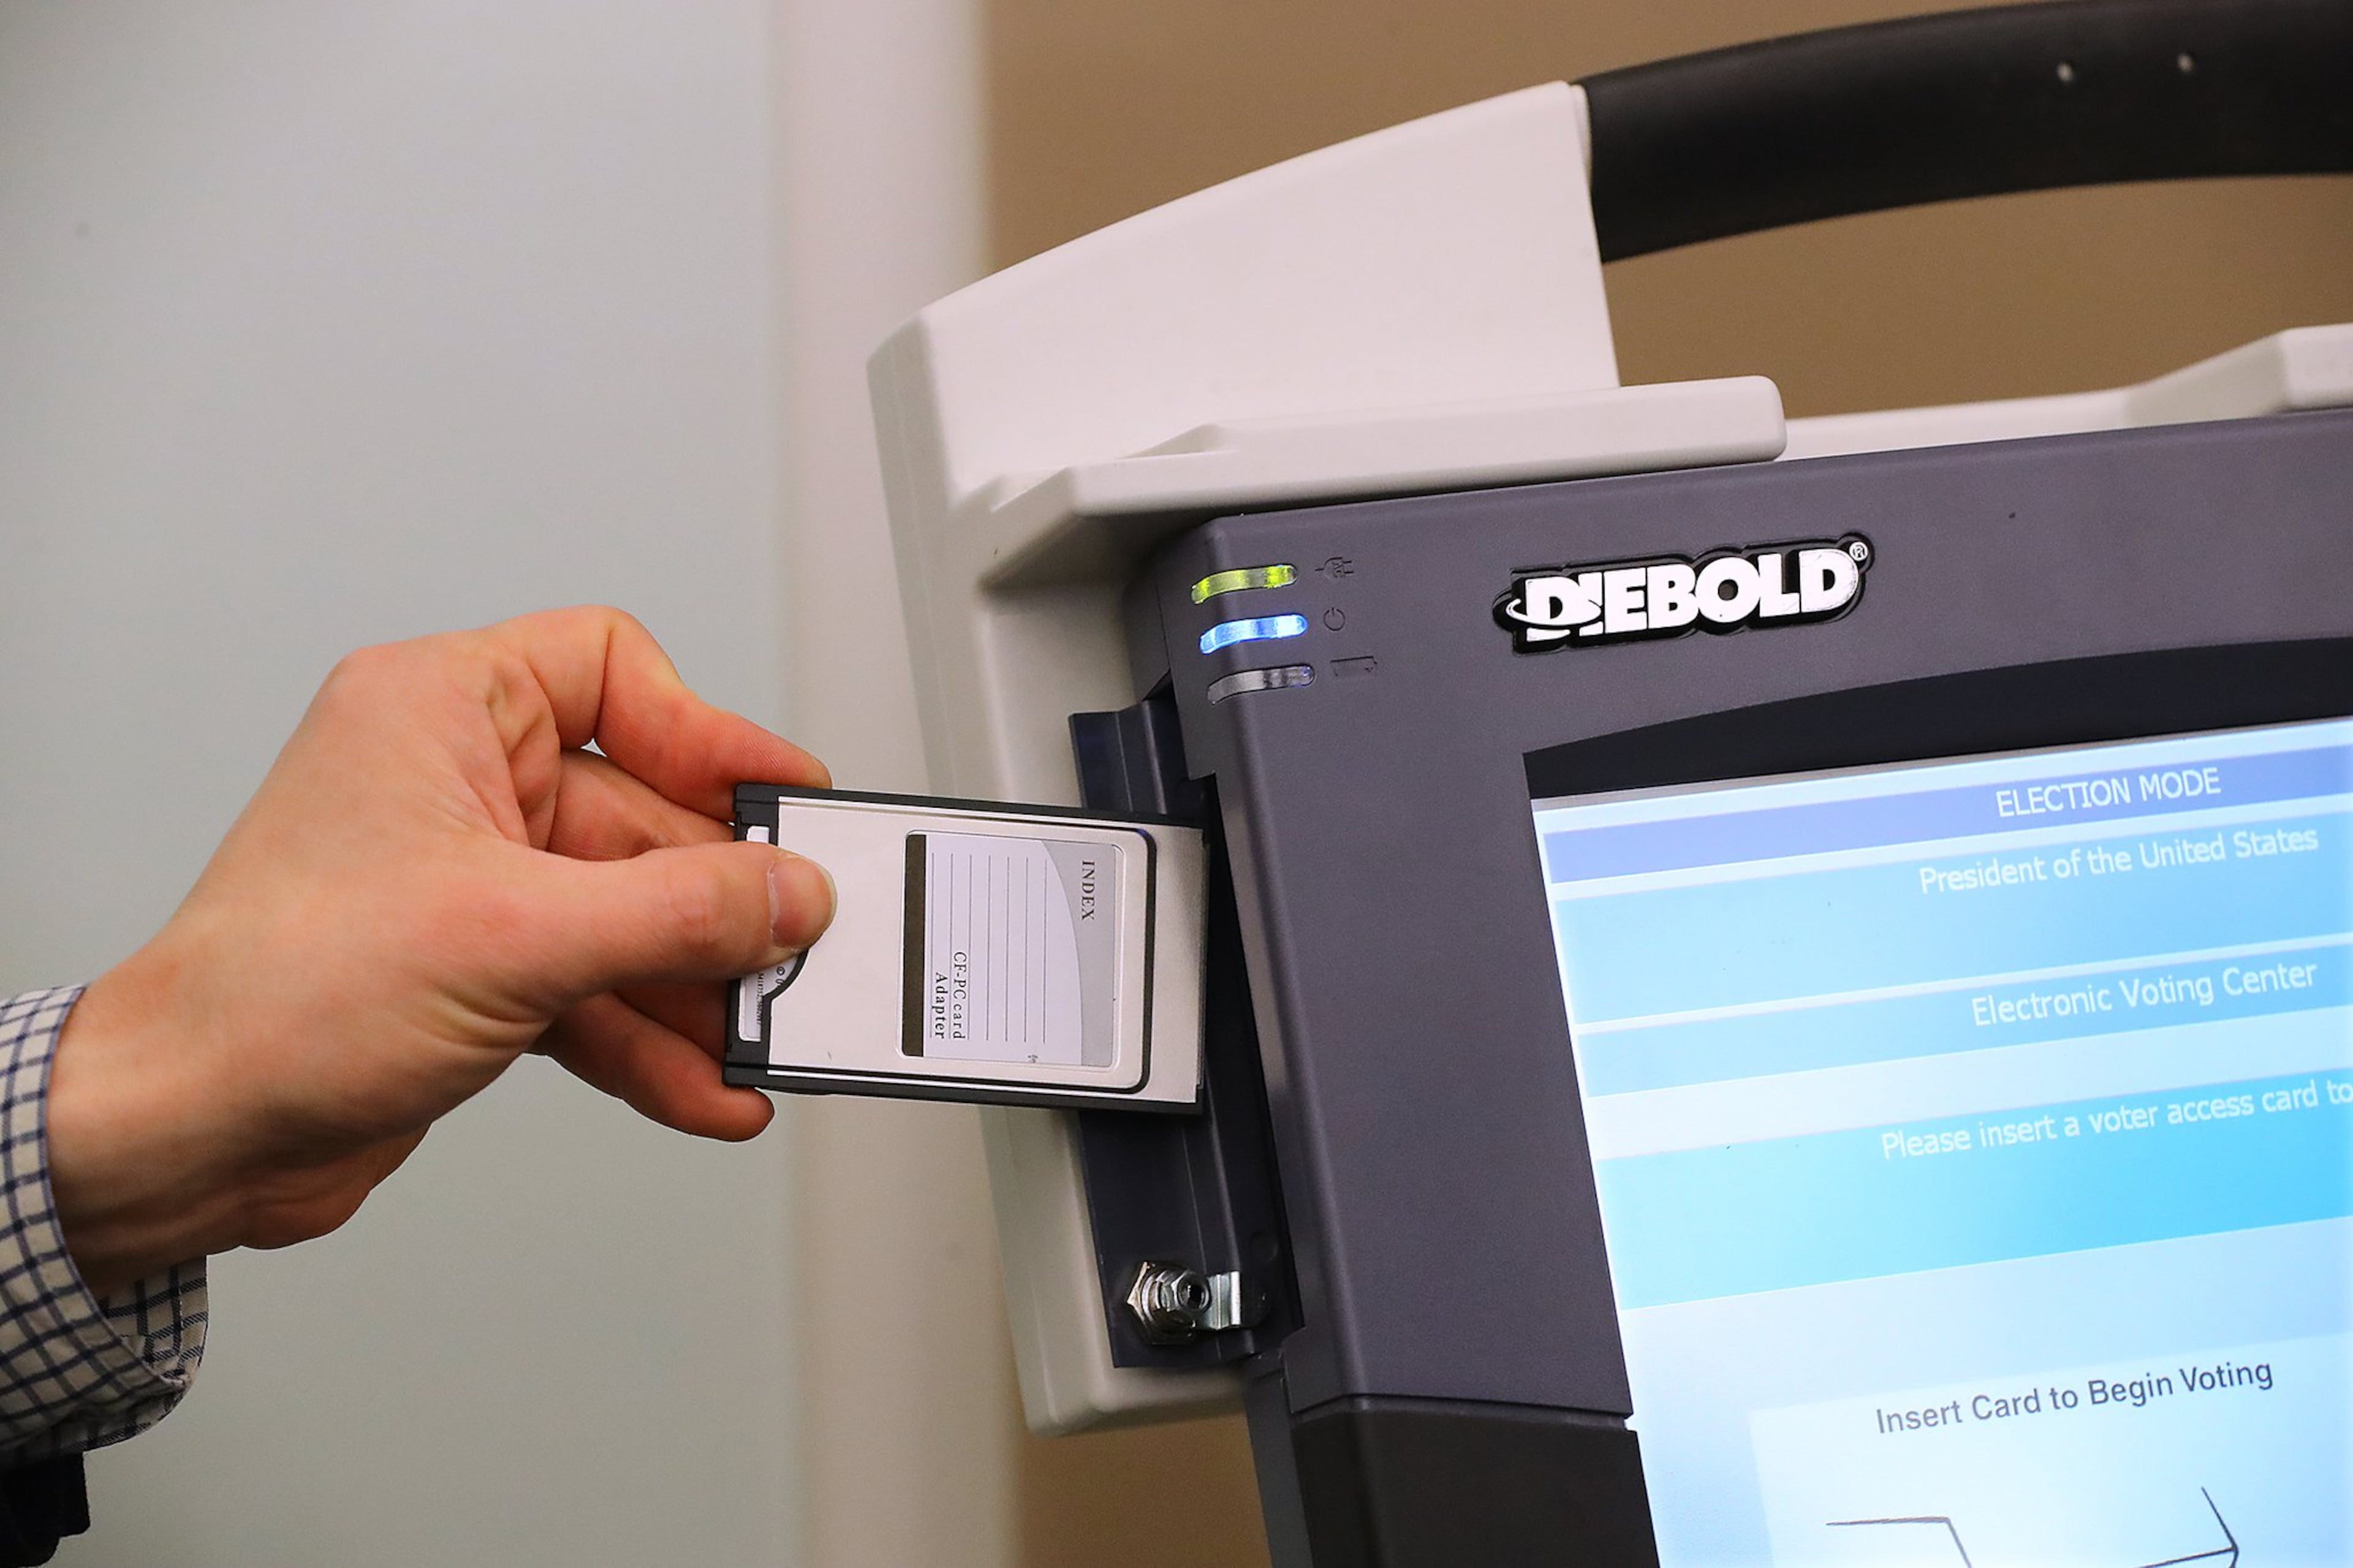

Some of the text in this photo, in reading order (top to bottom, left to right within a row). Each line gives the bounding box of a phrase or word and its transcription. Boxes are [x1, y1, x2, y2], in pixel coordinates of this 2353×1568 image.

[1996, 767, 2222, 818] ELECTION MODE
[1082, 860, 1095, 920] INDEX
[1919, 827, 2319, 894] President of the United States
[931, 972, 949, 1040] Adapter
[952, 952, 968, 1040] CF-PC card
[1971, 960, 2317, 1027] Electronic Voting Center
[1881, 1078, 2353, 1160] Please insert a voter access card to
[1876, 1360, 2275, 1434] Insert Card to Begin Voting
